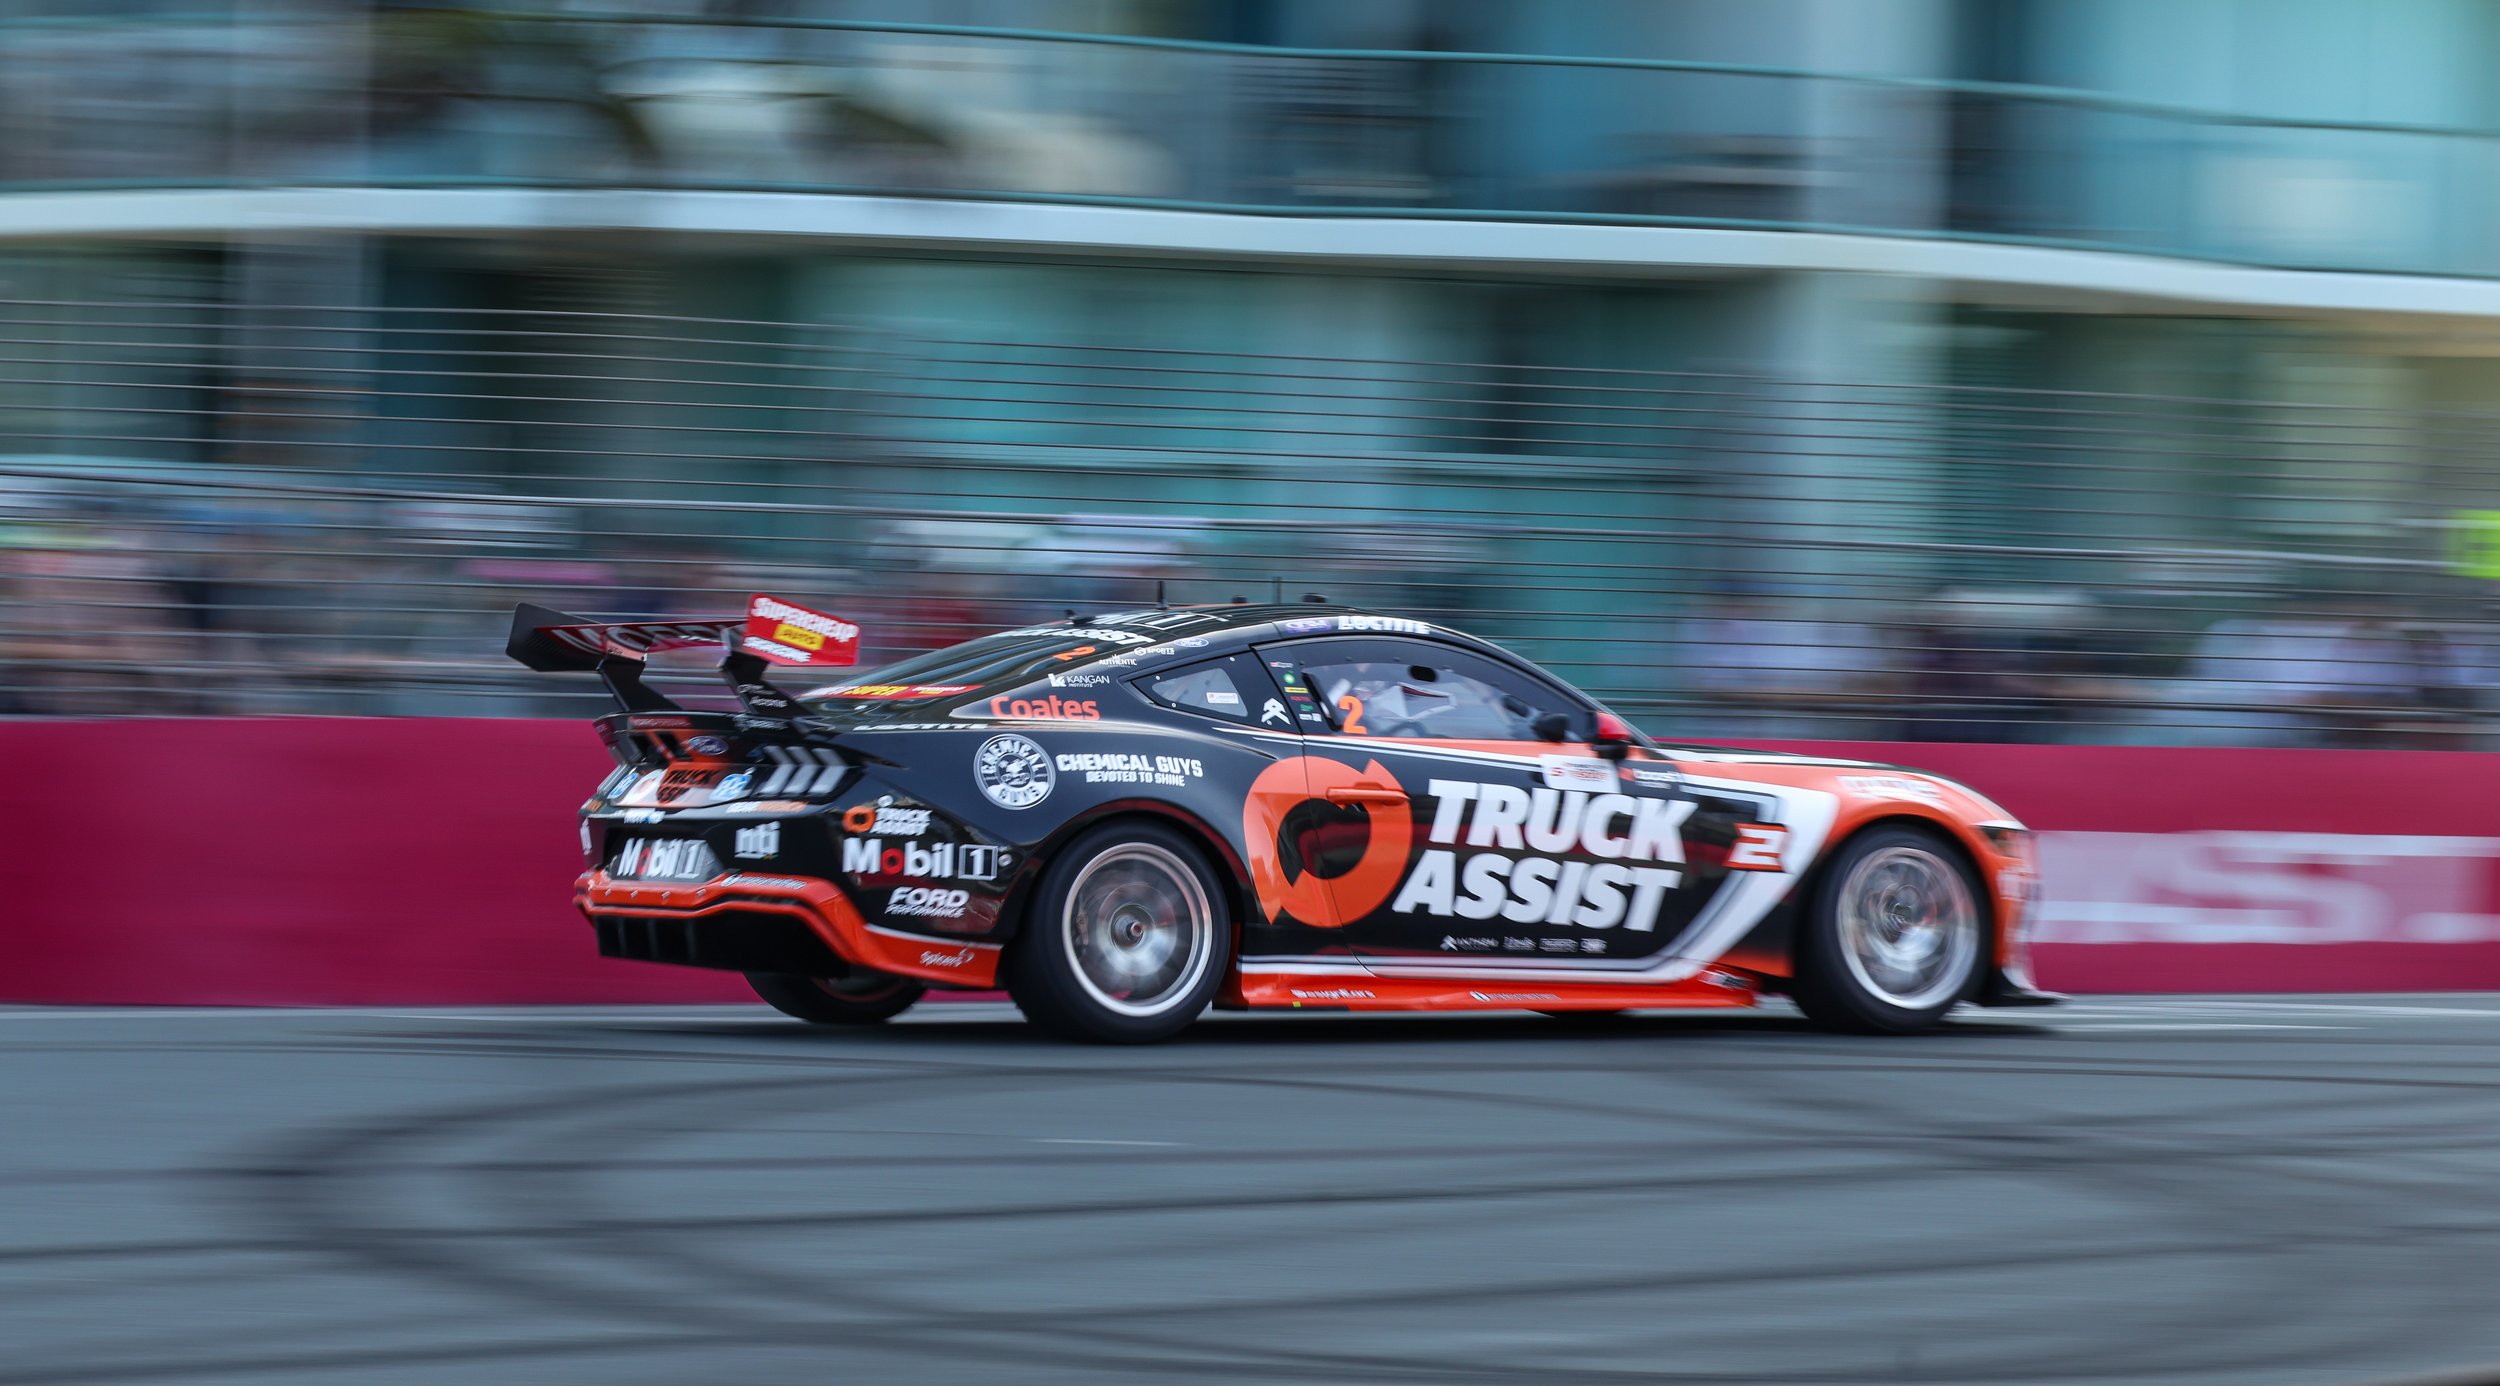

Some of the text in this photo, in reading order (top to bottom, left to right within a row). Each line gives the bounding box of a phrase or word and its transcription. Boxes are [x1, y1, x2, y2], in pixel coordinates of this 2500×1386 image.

[750, 597, 860, 643] SUPERCHEAP
[1338, 615, 1432, 635] LOCTITE
[1099, 657, 1138, 667] AUTHENTIC
[1066, 674, 1111, 685] KANGAN
[990, 695, 1100, 721] Coates
[1338, 695, 1368, 735] 2
[1055, 753, 1204, 778] CHEMICAL GUYS
[1086, 770, 1186, 788] DEVOTED TO SHINE
[1428, 778, 1698, 864] TRUCK
[617, 838, 685, 878] Mobil
[842, 837, 955, 878] Mobil
[888, 886, 969, 909] FORD
[1391, 849, 1683, 933] ASSIST
